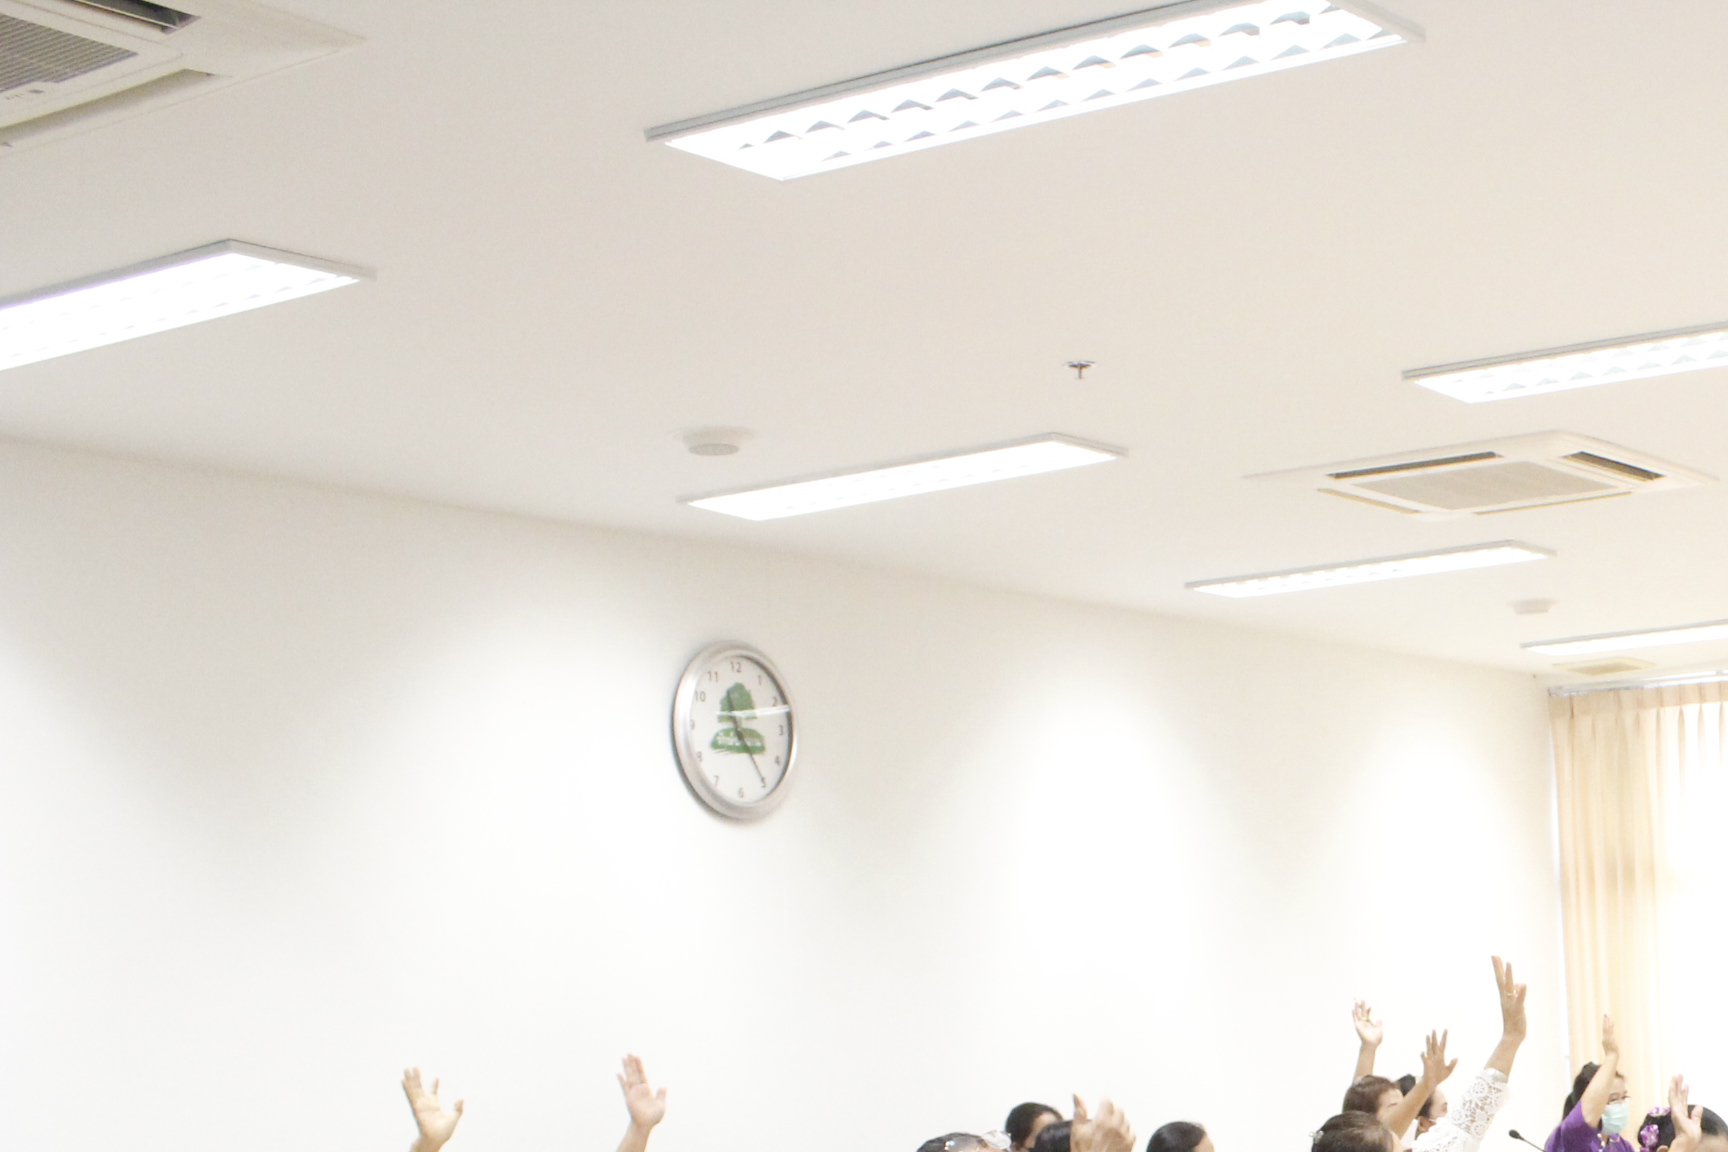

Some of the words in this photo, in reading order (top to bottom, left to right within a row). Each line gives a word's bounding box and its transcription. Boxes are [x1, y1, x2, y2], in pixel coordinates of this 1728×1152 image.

[730, 661, 742, 673] 12
[707, 671, 719, 683] 11
[757, 675, 762, 686] 1
[695, 690, 706, 702] 10
[778, 725, 784, 736] 3
[774, 755, 780, 766] 4
[714, 775, 719, 786] 7
[739, 787, 744, 798] 6
